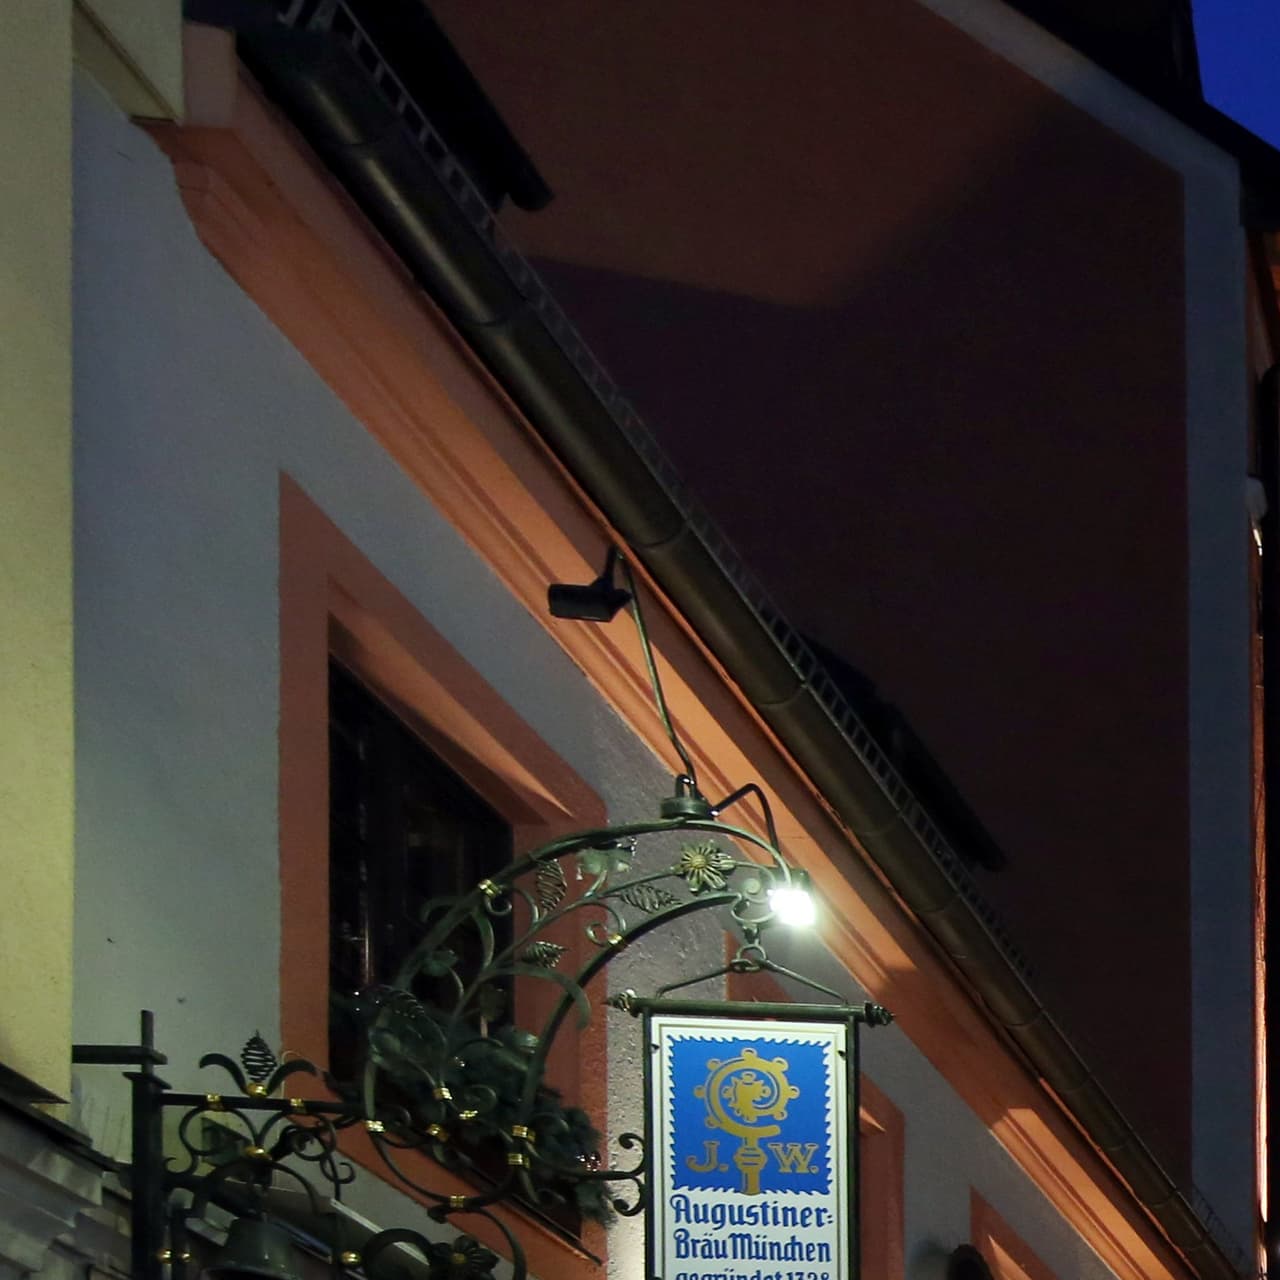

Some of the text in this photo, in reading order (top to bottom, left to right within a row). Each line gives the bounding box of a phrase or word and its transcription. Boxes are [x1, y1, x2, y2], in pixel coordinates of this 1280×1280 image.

[685, 1141, 820, 1174] J. W.
[674, 1229, 832, 1263] Bräu München
